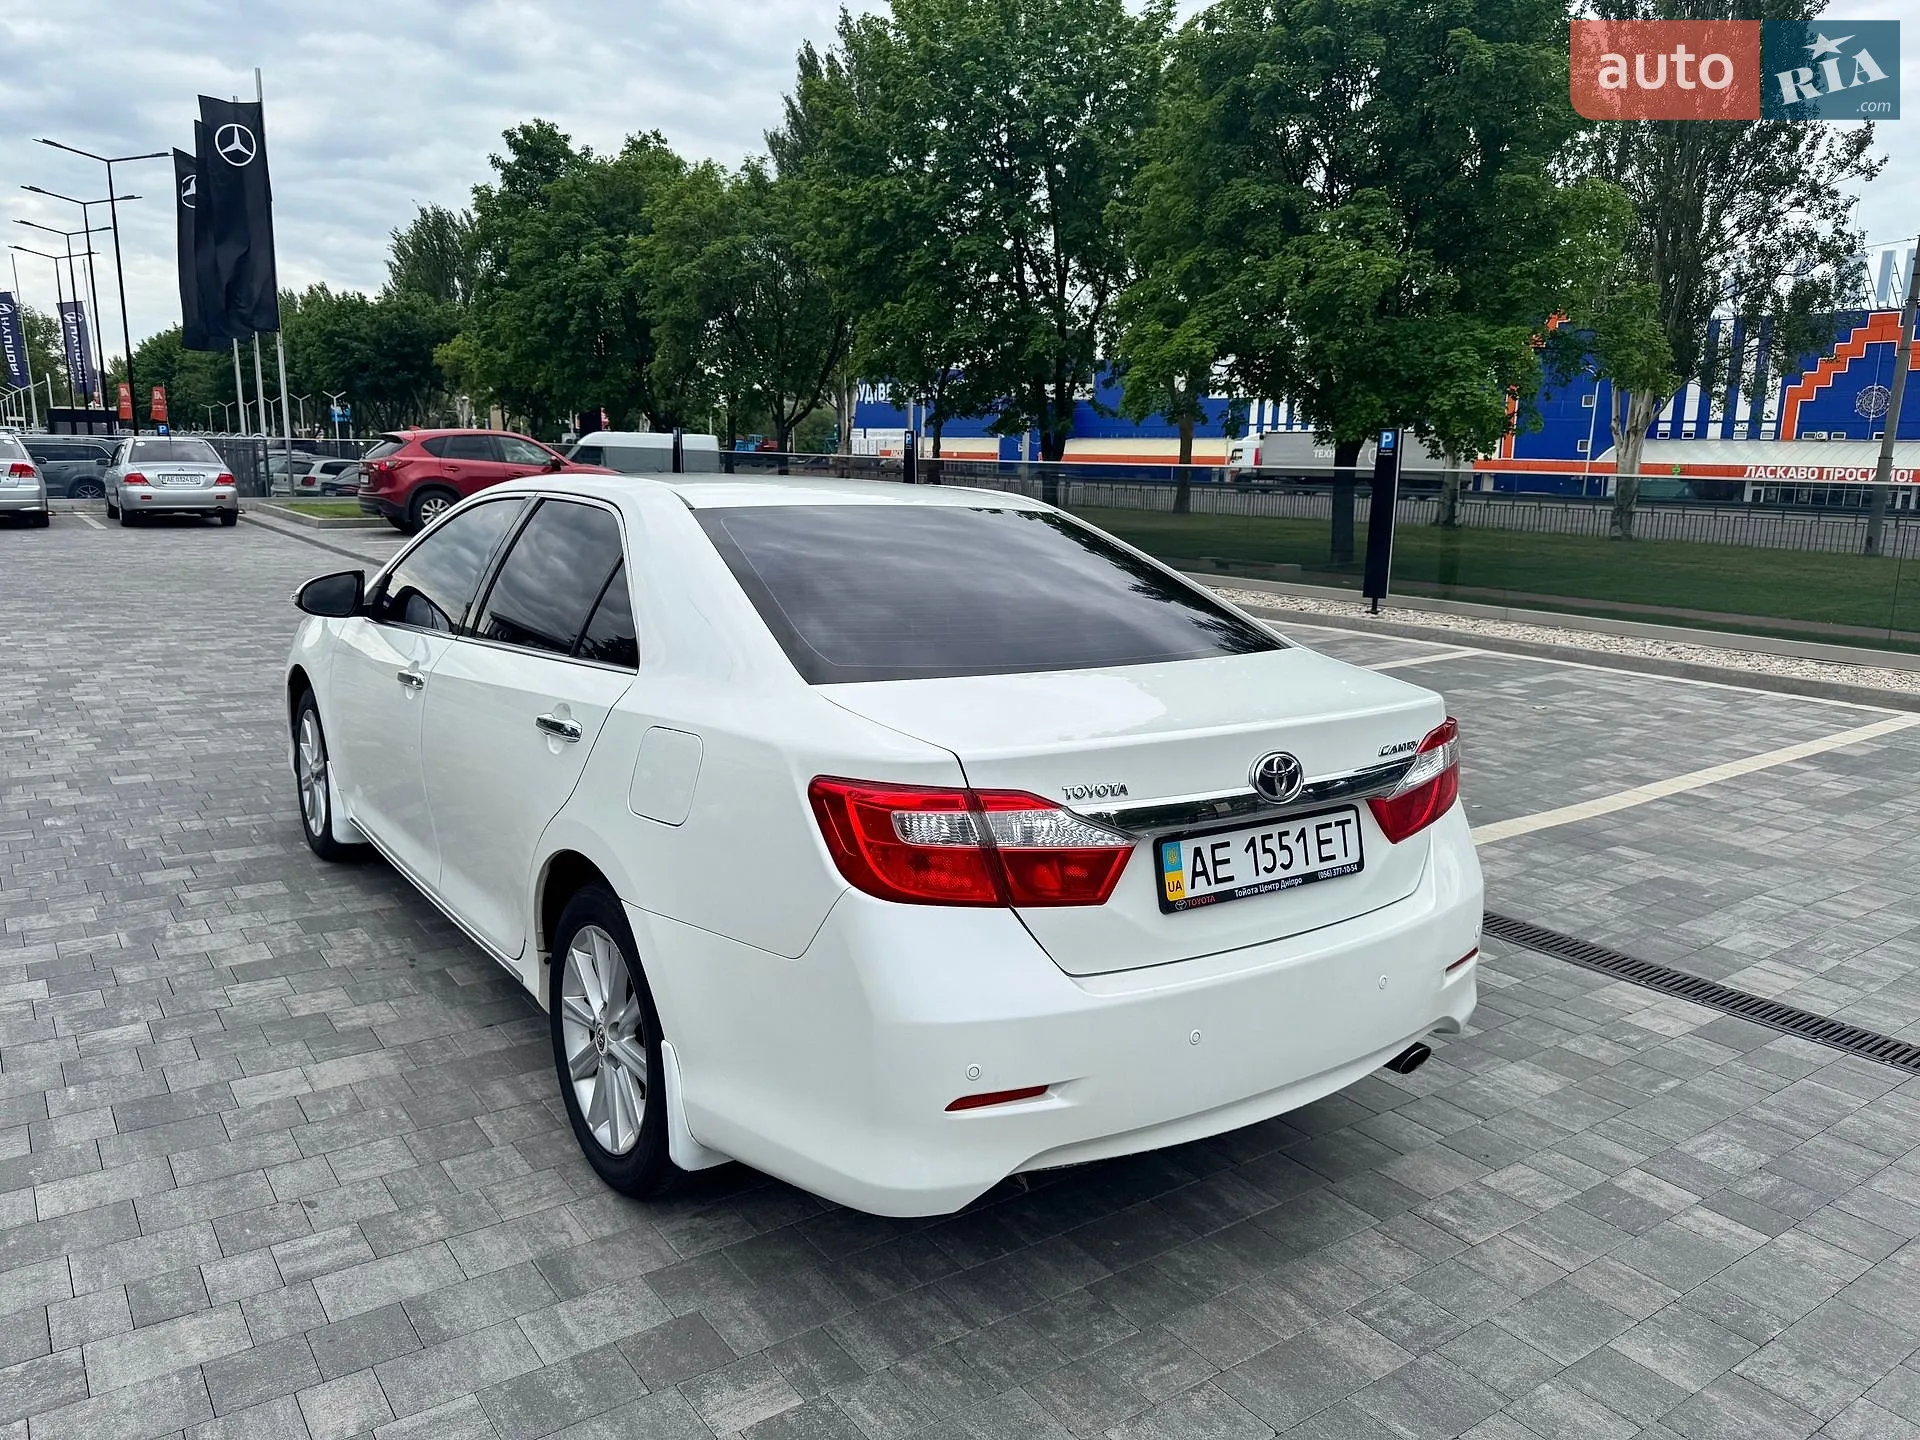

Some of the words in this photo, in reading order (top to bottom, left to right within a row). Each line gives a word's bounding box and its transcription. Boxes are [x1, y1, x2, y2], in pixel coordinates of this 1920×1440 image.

[1382, 432, 1392, 447] P
[1743, 465, 1819, 480] ЛАСКАВО
[1822, 467, 1915, 483] ПРОСИО!
[1378, 740, 1419, 756] CAMRY
[1061, 782, 1129, 801] TOYOTA
[1190, 841, 1234, 889] AE
[1244, 827, 1309, 876] 1551
[1316, 819, 1351, 862] ET
[1167, 880, 1183, 893] UA
[1234, 887, 1259, 898] Тойота
[1259, 880, 1281, 894] Центр
[1280, 876, 1303, 890] Дніпро
[1187, 895, 1216, 907] TOYOTA
